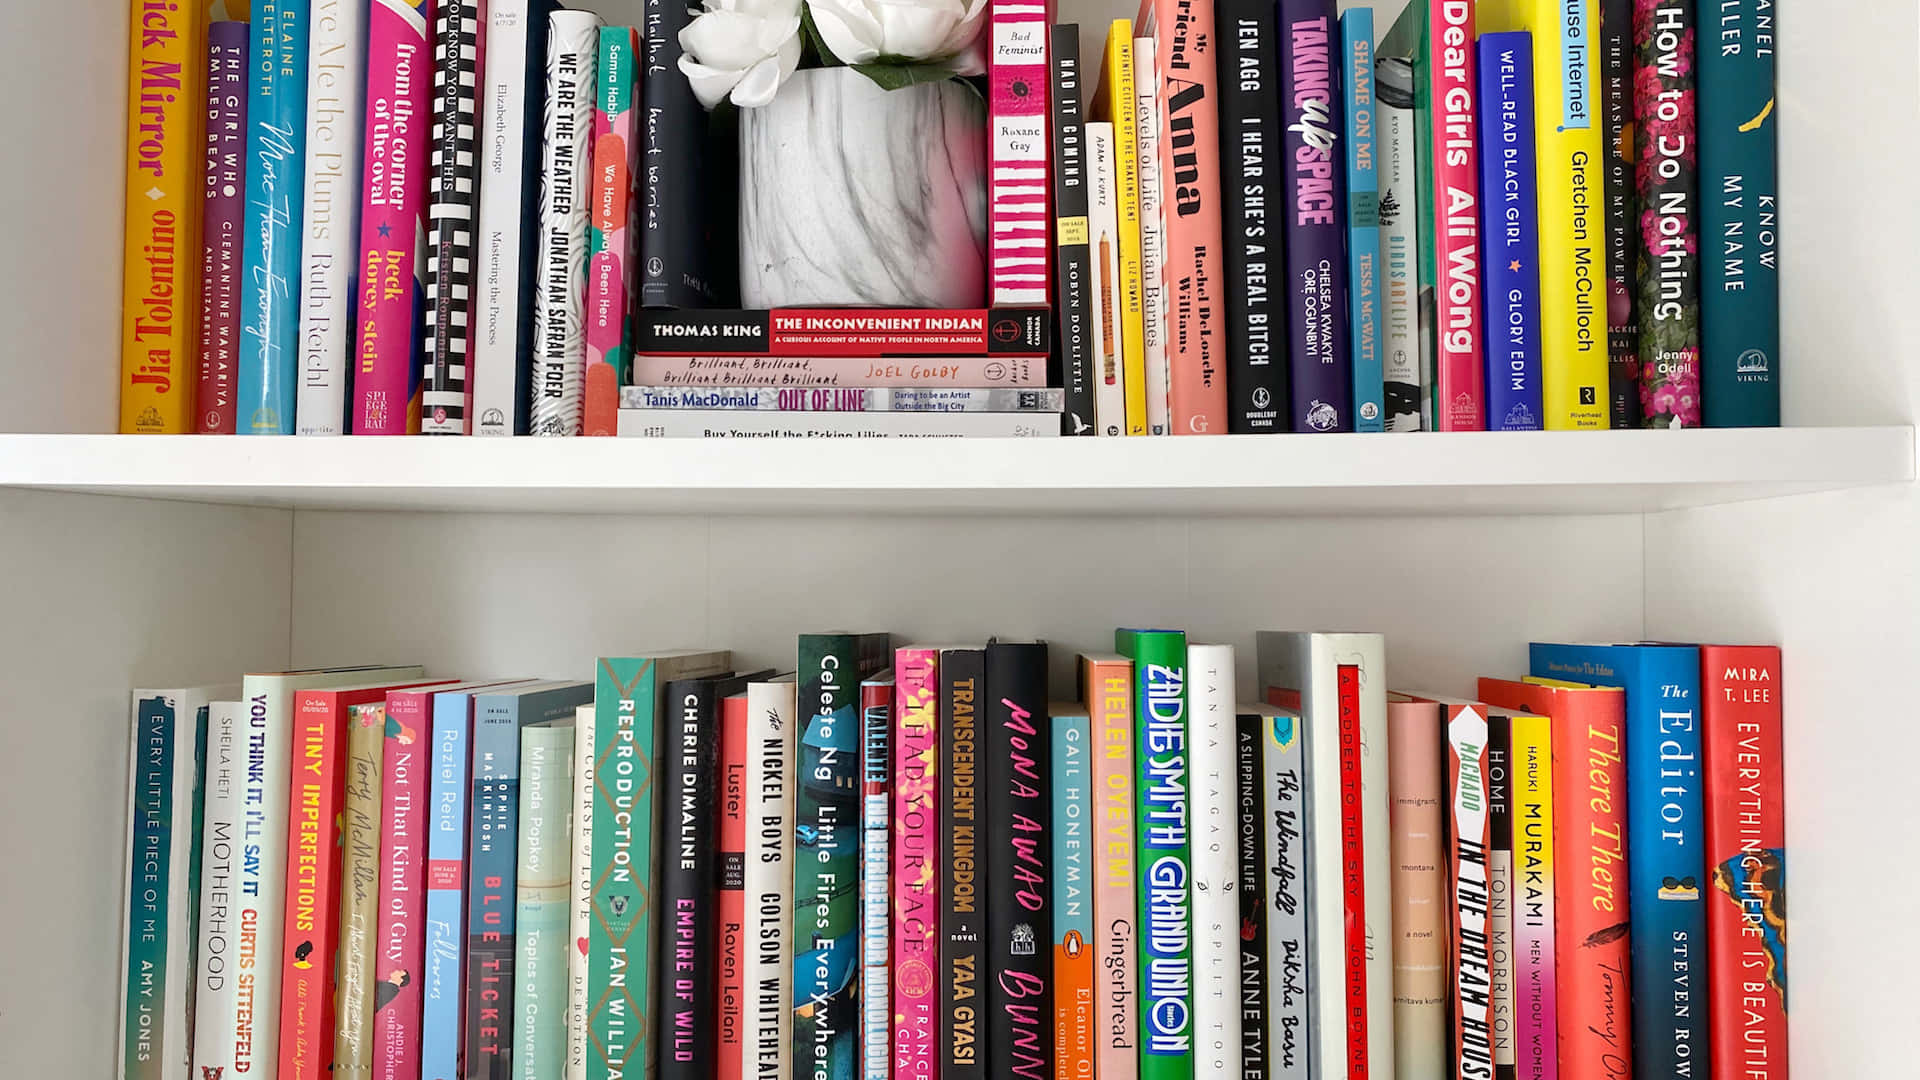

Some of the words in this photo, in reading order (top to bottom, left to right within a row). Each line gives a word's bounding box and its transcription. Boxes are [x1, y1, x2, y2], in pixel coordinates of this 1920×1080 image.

[282, 11, 296, 76] ELAINE
[447, 30, 458, 72] KNOW
[998, 45, 1044, 55] Feminist
[1010, 32, 1031, 41] Bad
[1443, 1, 1468, 83] Dear
[1610, 36, 1620, 68] THE
[209, 46, 221, 120] SMILED
[226, 48, 240, 82] THE
[395, 43, 416, 96] from
[560, 53, 577, 75] WE
[1060, 59, 1075, 89] HAD
[1353, 40, 1369, 105] SHAME
[1567, 45, 1586, 120] Internet
[374, 98, 390, 120] of
[446, 75, 457, 107] YOU
[495, 84, 507, 133] Elizabeth
[557, 80, 575, 109] ARE
[1062, 99, 1077, 115] IT
[138, 59, 181, 177] Mirror
[225, 96, 240, 142] GIRL
[373, 124, 389, 159] the
[393, 100, 413, 134] the
[444, 110, 457, 152] WANT
[556, 113, 574, 140] THE
[648, 108, 662, 155] heart
[1355, 110, 1371, 138] ON
[1391, 116, 1400, 135] KYO
[1445, 87, 1473, 167] Girls
[1611, 77, 1623, 158] MEASURE
[207, 135, 219, 198] BEADS
[492, 135, 506, 173] George
[1063, 125, 1080, 187] COMING
[1166, 75, 1205, 218] Anna
[1356, 143, 1372, 170] ME
[1391, 138, 1400, 183] MACLEAR
[371, 161, 386, 205] oval
[389, 137, 408, 210] corner
[443, 156, 456, 191] THIS
[553, 145, 573, 215] WEATHER
[647, 165, 663, 229] berries
[1613, 166, 1623, 187] OF
[1447, 186, 1476, 237] Ali
[1614, 195, 1624, 218] MY
[1758, 195, 1776, 269] KNOW
[135, 210, 176, 343] Tolentino
[384, 250, 405, 300] beck
[549, 227, 568, 304] JONATHAN
[1068, 262, 1081, 308] ROBYN
[1319, 260, 1332, 312] CHELSEA
[1614, 227, 1625, 295] POWERS
[1179, 276, 1192, 354] Williams
[1444, 245, 1477, 353] Wong
[547, 309, 567, 359] SAFRAN
[654, 325, 718, 336] THOMAS
[723, 325, 761, 336] KING
[1304, 296, 1319, 356] OGUNBIYI
[1321, 314, 1334, 364] KWAKYE
[131, 349, 171, 393] Jia
[689, 358, 749, 372] Brilliant,
[753, 358, 813, 372] Brilliant,
[1070, 315, 1083, 393] DOOLITTLE
[1655, 350, 1693, 361] Jenny
[545, 362, 564, 398] FOER
[644, 393, 679, 406] Tanis
[682, 393, 759, 407] MacDonald
[778, 389, 808, 411] OUT
[812, 389, 830, 411] OF
[834, 389, 865, 411] LINE
[895, 391, 918, 401] Daring
[928, 391, 938, 399] be
[950, 391, 970, 399] Artist
[937, 402, 949, 411] Big
[950, 402, 965, 411] City
[820, 654, 840, 739] Celeste
[1341, 675, 1350, 684] A
[1660, 685, 1689, 698] The
[250, 694, 267, 728] YOU
[1105, 678, 1127, 759] HELEN
[1207, 667, 1218, 748] TANYA
[1341, 693, 1354, 772] LADDER
[219, 718, 232, 765] SHEILA
[248, 732, 265, 783] THINK
[304, 723, 324, 776] TINY
[440, 730, 458, 784] Raziel
[815, 747, 838, 780] Ng
[953, 678, 975, 820] TRANSCENDENT
[217, 769, 232, 799] HETI
[347, 752, 377, 801] Terry
[613, 700, 636, 882] REPRODUCTION
[727, 764, 744, 820] Luster
[1276, 769, 1300, 801] The
[1345, 782, 1356, 804] TO
[1460, 742, 1480, 812] MACHADO
[1489, 750, 1505, 814] HOME
[1527, 746, 1538, 792] HARUKI
[1589, 724, 1621, 814] There
[1659, 708, 1695, 845] Editor
[246, 788, 262, 806] IT,
[440, 791, 457, 832] Reid
[497, 773, 508, 831] SOPHIE
[1209, 771, 1221, 853] TAGAQ
[245, 810, 265, 841] I'LL
[818, 806, 838, 864] Little
[1107, 773, 1130, 887] OYEYEMI
[1346, 816, 1357, 850] THE
[243, 844, 260, 876] SAY
[296, 785, 321, 931] IMPERFECTIONS
[349, 808, 378, 906] McMillan
[953, 825, 975, 912] KINGDOM
[1271, 810, 1299, 916] Windfall
[1457, 838, 1487, 866] IN
[1525, 803, 1544, 926] MURAKAMI
[1591, 823, 1624, 912] There
[242, 881, 258, 897] IT
[816, 873, 836, 929] Fires
[1348, 861, 1358, 896] SKY
[1458, 876, 1487, 920] THE
[1491, 867, 1506, 918] TONI
[207, 822, 231, 991] MOTHERHOOD
[239, 909, 257, 969] CURTIS
[724, 922, 741, 979] Raven
[951, 933, 977, 941] novel
[1212, 923, 1222, 998] SPLIT
[1530, 939, 1541, 965] MEN
[575, 976, 583, 996] DE
[609, 947, 626, 987] IAN
[1105, 919, 1132, 1049] Gingerbread
[1282, 939, 1304, 1008] Diksha
[1350, 944, 1361, 997] JOHN
[1459, 927, 1490, 1008] DREAM
[1493, 931, 1509, 1049] MORRISON
[1672, 931, 1690, 1018] STEVEN
[235, 974, 255, 1073] SITTENFELD
[723, 986, 739, 1044] Leilani
[811, 938, 836, 1080] Everywhere
[1531, 970, 1542, 1029] WITHOUT
[1588, 956, 1627, 1048] Tommy
[573, 1004, 583, 1066] BOTTON
[898, 1029, 910, 1069] CHA
[1214, 1022, 1223, 1069] TOO
[1282, 1015, 1300, 1069] Basu
[1353, 1007, 1364, 1073] BOYNE
